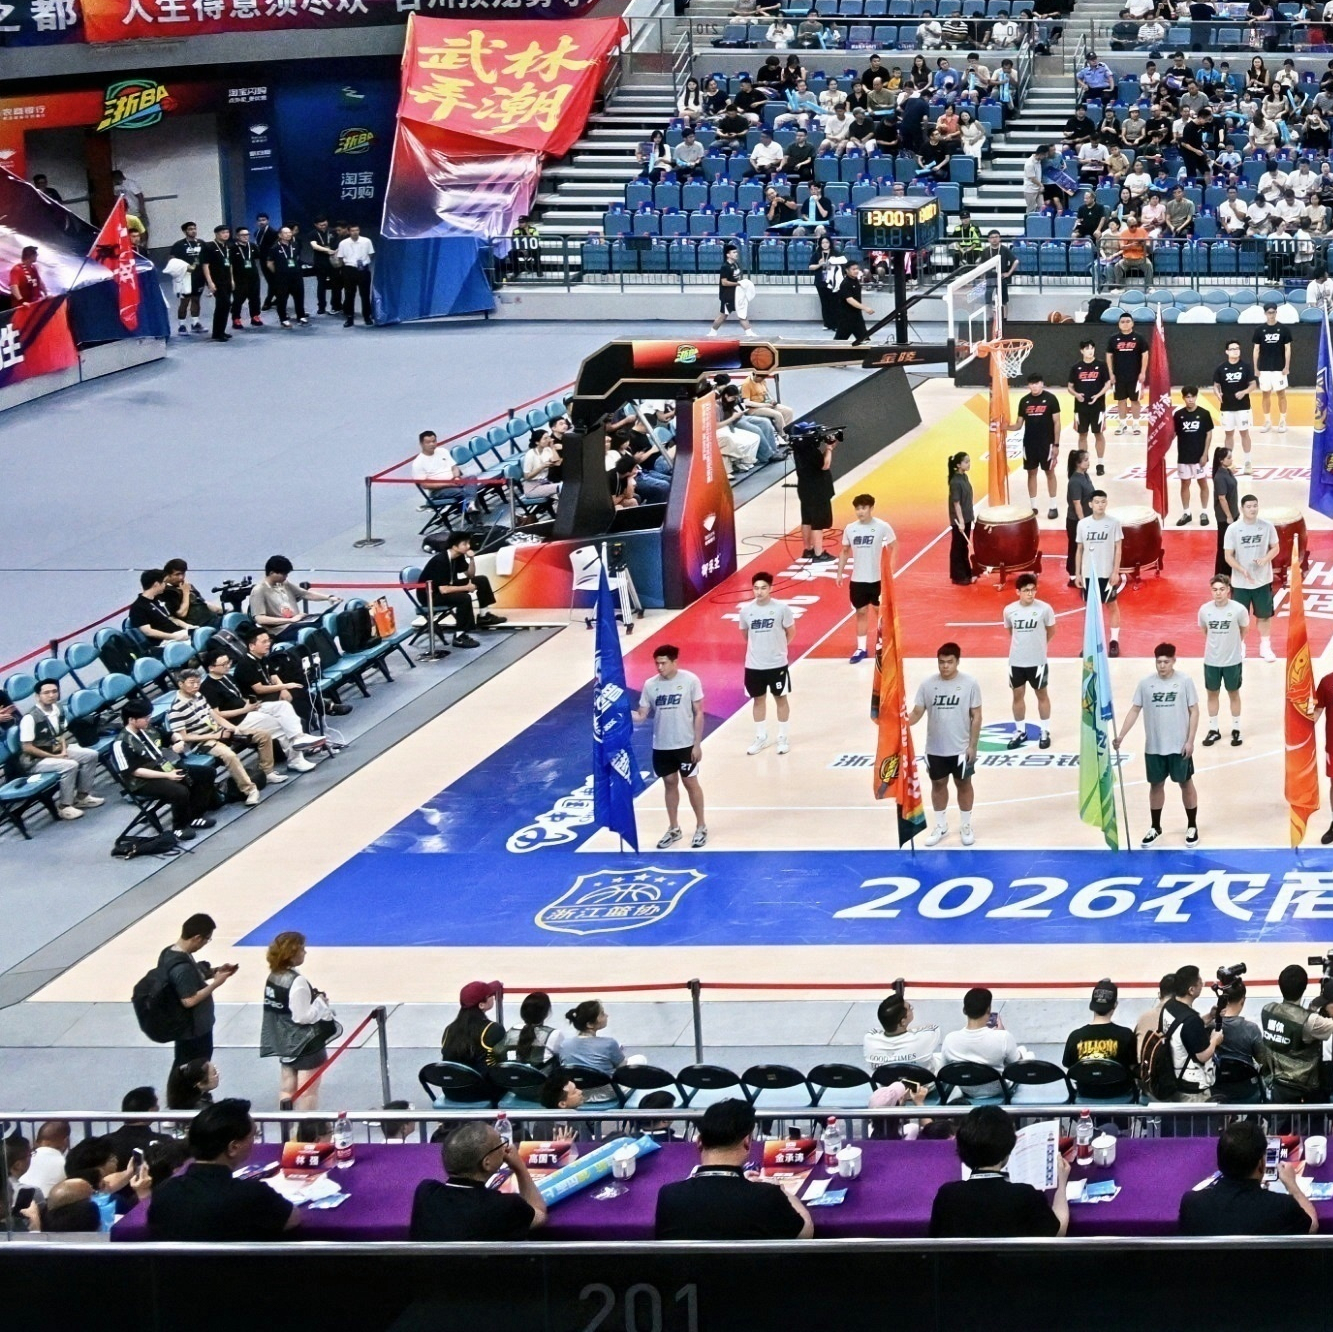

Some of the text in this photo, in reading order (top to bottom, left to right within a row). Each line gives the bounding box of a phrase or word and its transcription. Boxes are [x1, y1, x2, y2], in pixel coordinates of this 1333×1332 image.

[418, 29, 602, 84] 武林
[228, 86, 268, 97] 淘宝闪购
[341, 171, 374, 186] 淘宝
[341, 187, 375, 200] 闪购
[513, 237, 539, 250] 110
[1272, 241, 1295, 253] 111
[1086, 532, 1109, 541] 江山
[1240, 534, 1263, 544] 安吉
[750, 618, 775, 629] 普陀
[1013, 618, 1038, 629] 江山
[1208, 620, 1232, 630] 安吉
[775, 681, 783, 690] 8
[655, 693, 683, 706] 普陀
[932, 694, 960, 706] 江山
[1151, 691, 1178, 703] 安吉
[681, 762, 692, 771] 27
[547, 903, 665, 922] 浙江篮协
[893, 1052, 917, 1062] TIMES
[528, 1153, 558, 1164] 高国飞
[775, 1152, 804, 1163] 金承涛
[579, 1281, 700, 1332] 201
